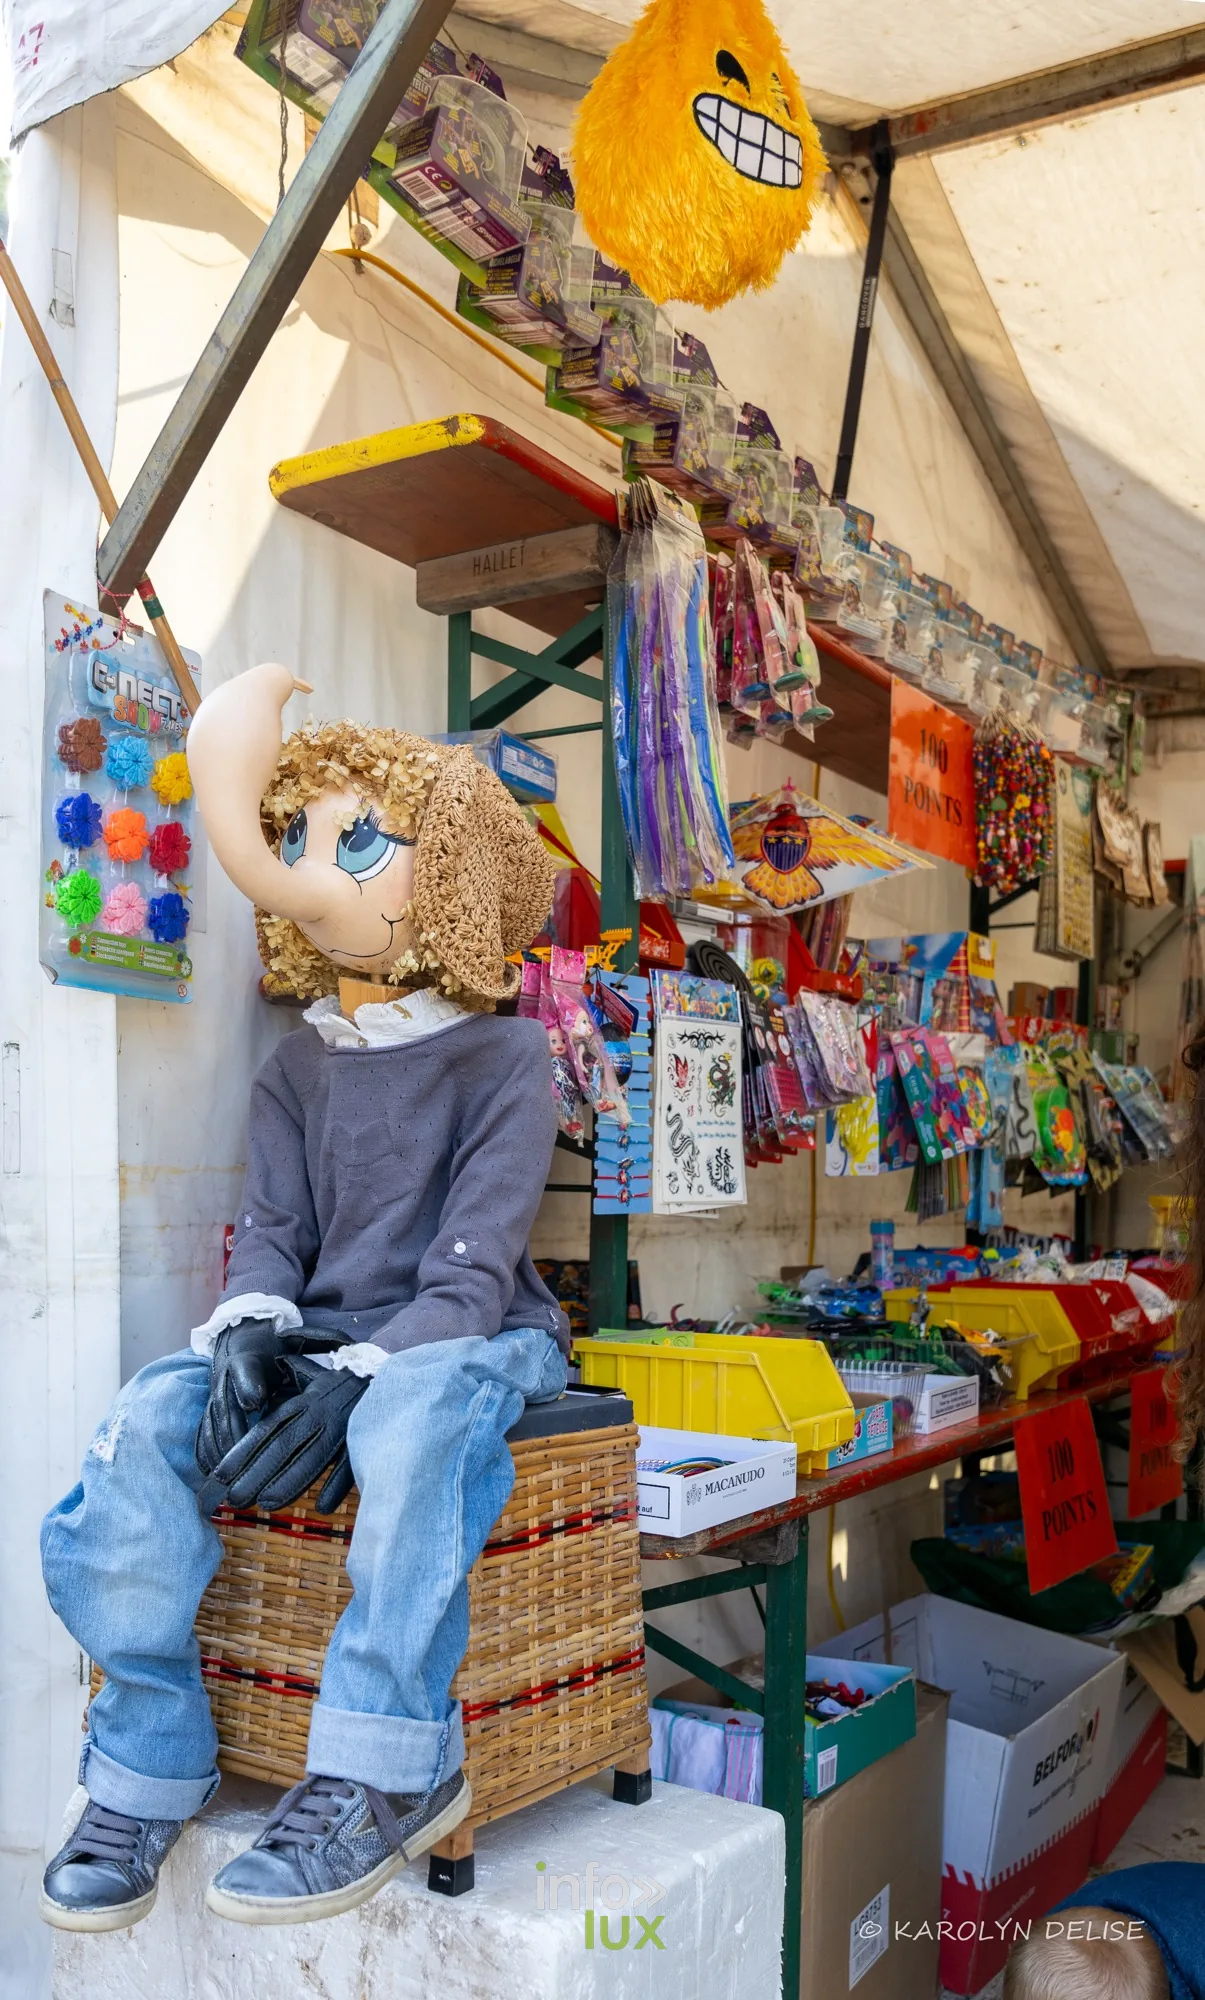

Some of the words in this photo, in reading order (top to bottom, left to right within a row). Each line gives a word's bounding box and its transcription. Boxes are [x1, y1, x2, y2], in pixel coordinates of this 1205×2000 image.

[424, 166, 442, 181] CE
[473, 545, 525, 577] HALLET
[920, 728, 948, 774] 100
[904, 775, 963, 827] POINTS
[1047, 1437, 1075, 1484] 100
[704, 1467, 765, 1496] MACANUDO
[641, 1505, 653, 1513] auf
[1041, 1490, 1097, 1542] POINTS
